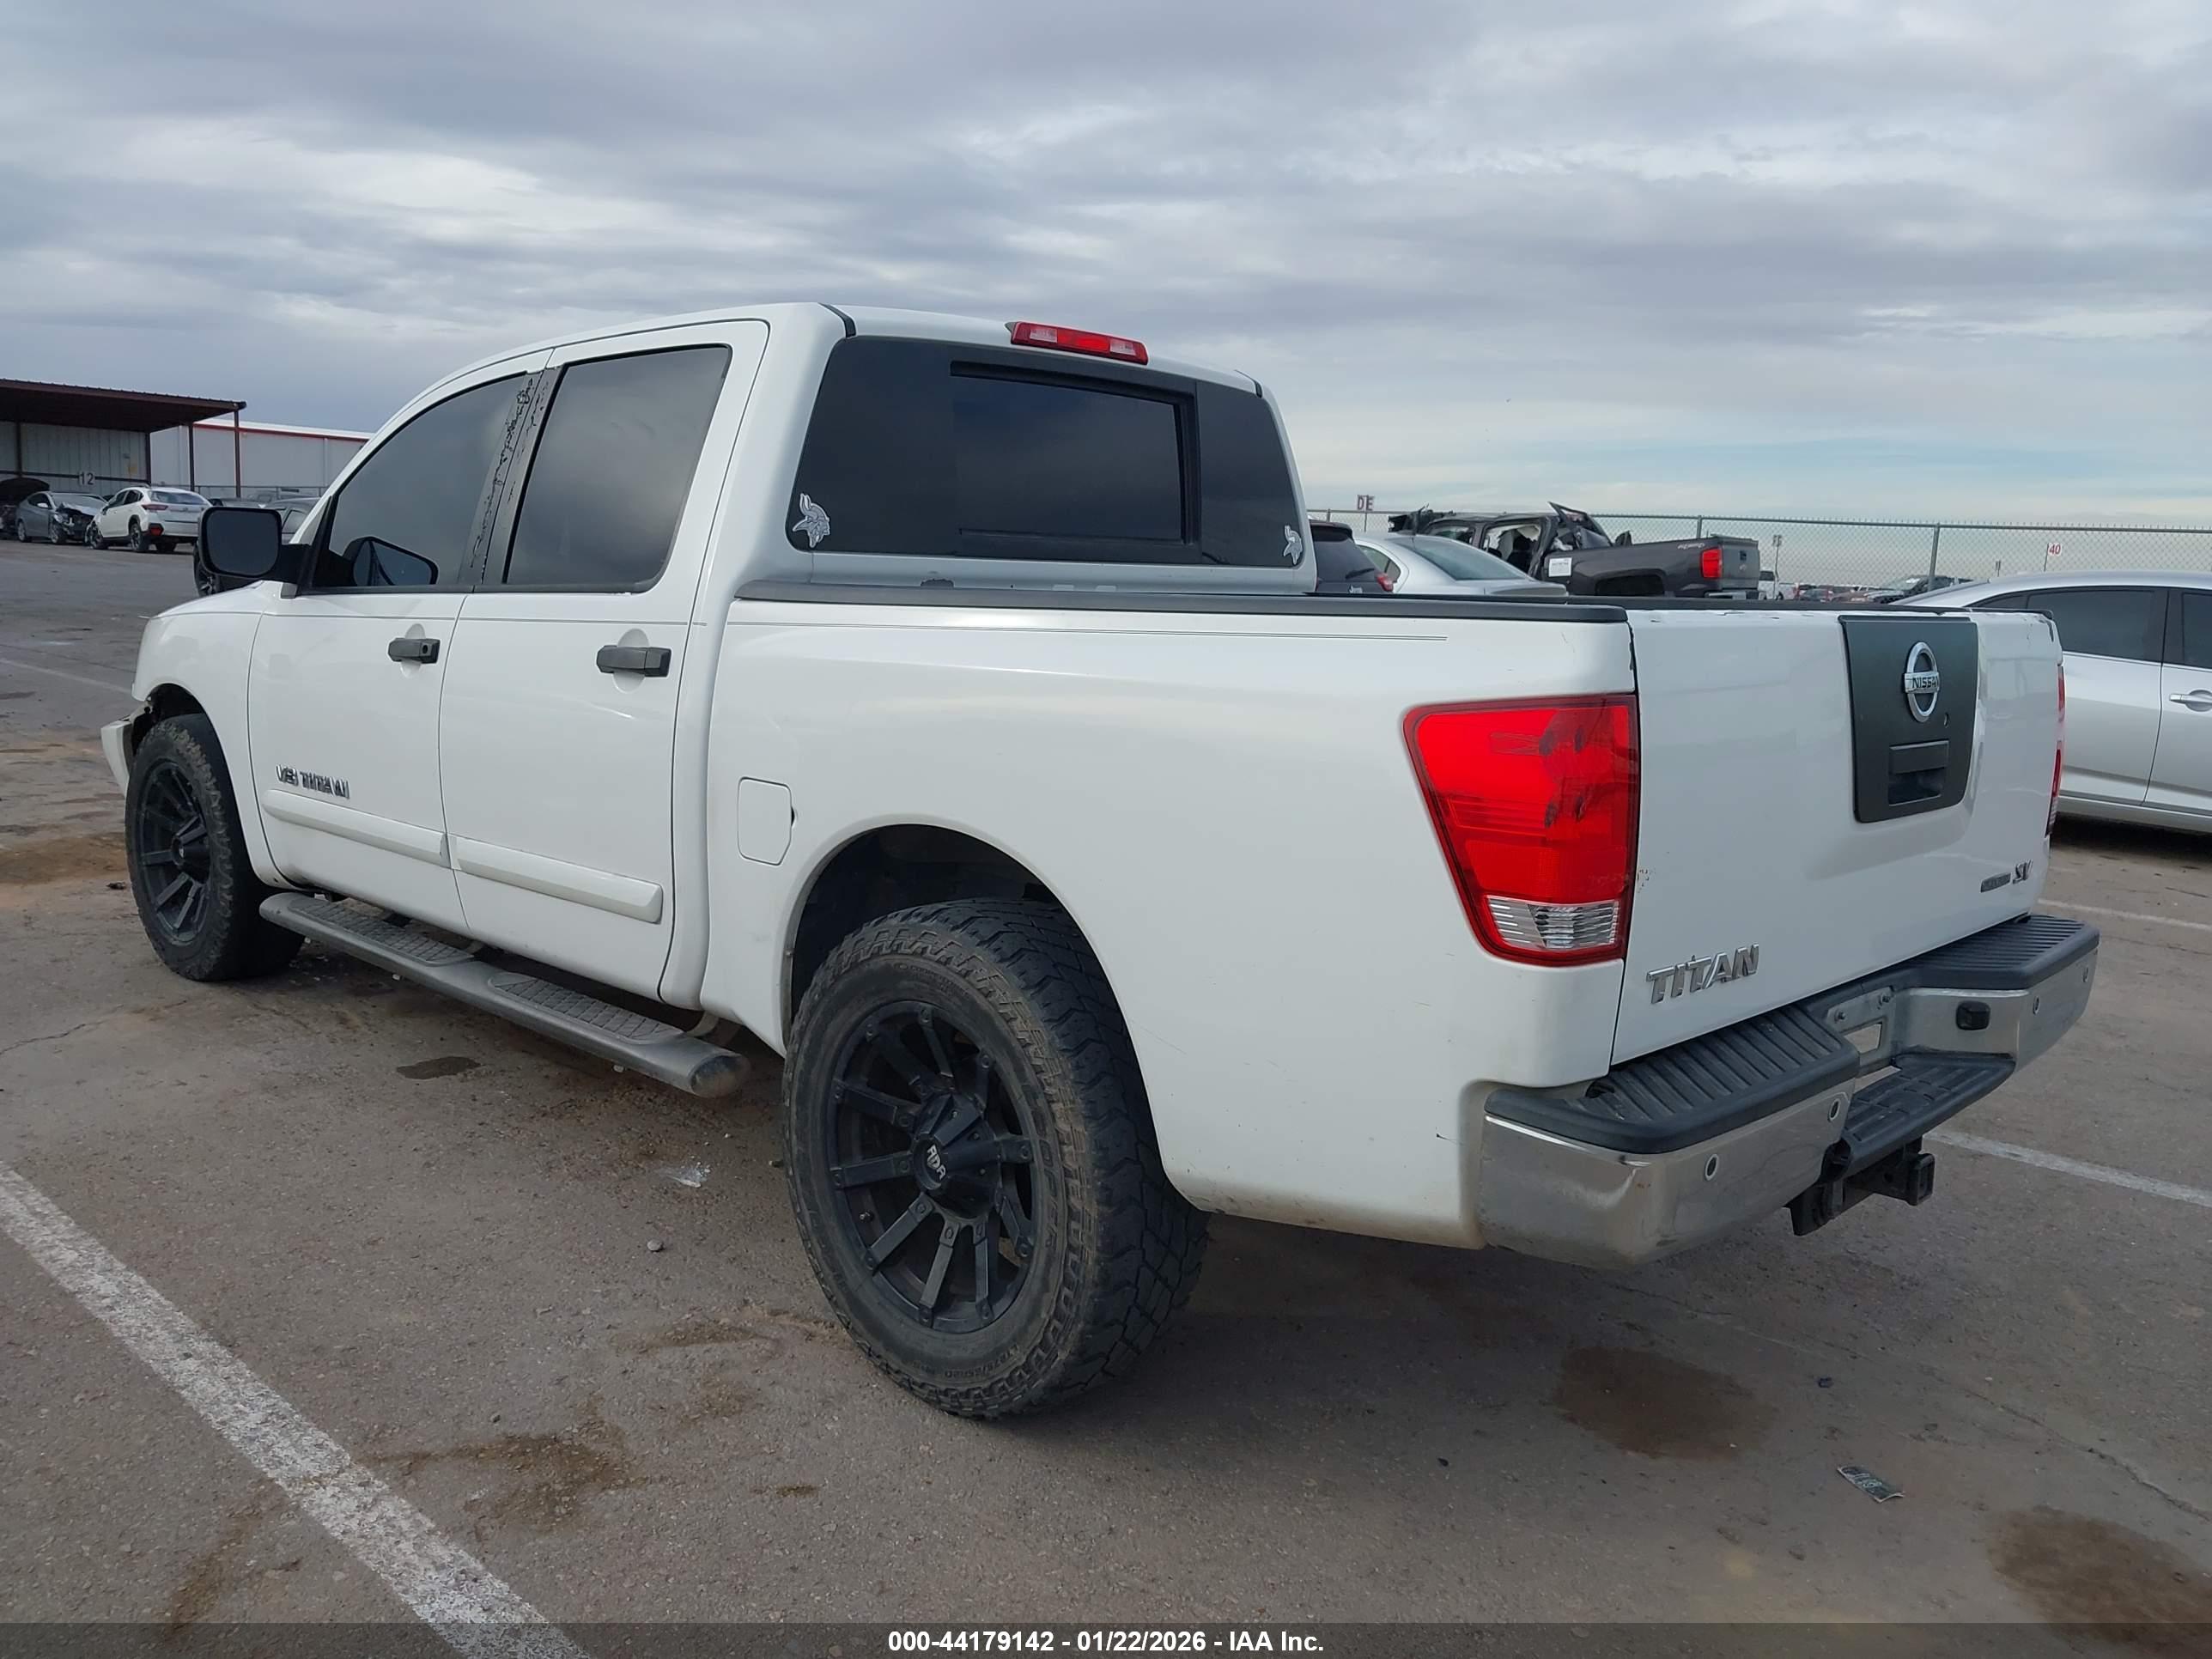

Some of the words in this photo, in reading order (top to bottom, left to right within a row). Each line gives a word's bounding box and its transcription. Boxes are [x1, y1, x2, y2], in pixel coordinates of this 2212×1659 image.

[80, 471, 94, 485] 12
[2049, 544, 2061, 555] 40
[276, 764, 299, 787] V8
[300, 771, 349, 799] TITAN
[1646, 943, 1759, 1004] TITAN
